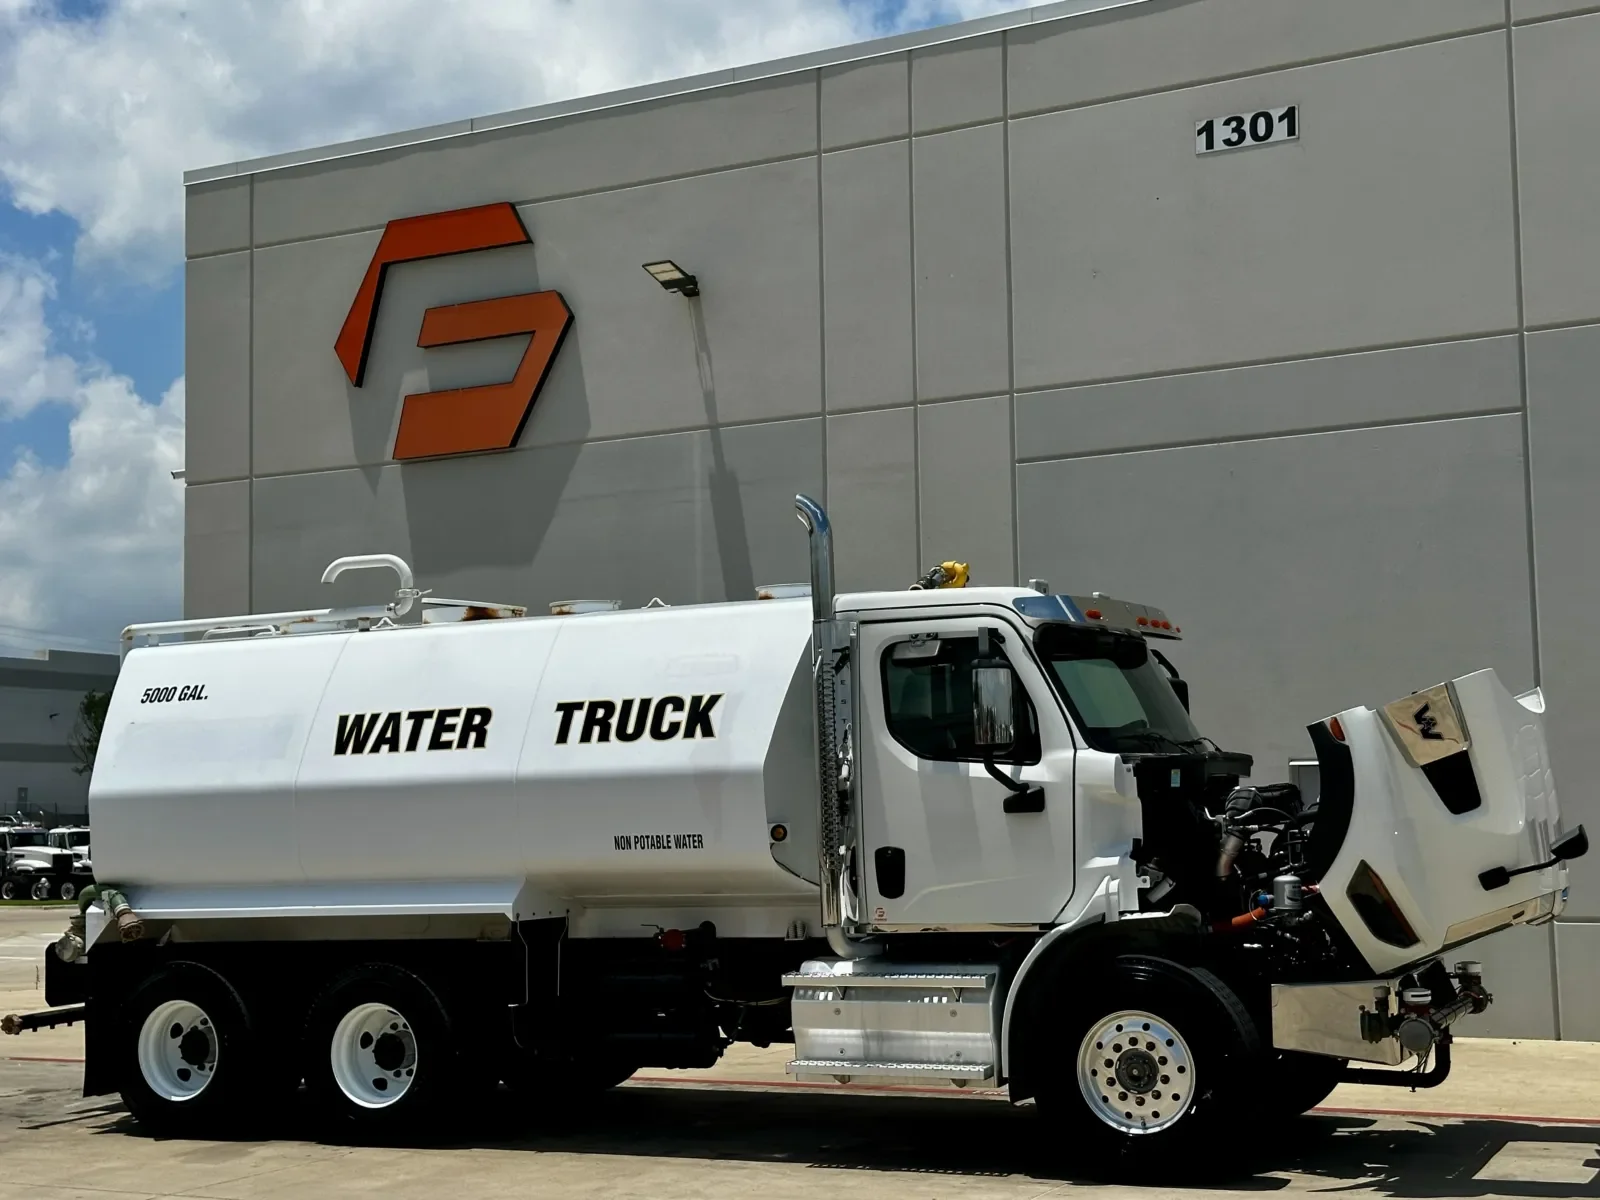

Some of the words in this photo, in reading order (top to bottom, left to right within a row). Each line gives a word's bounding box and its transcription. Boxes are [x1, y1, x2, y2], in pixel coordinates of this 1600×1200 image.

[1196, 105, 1297, 151] 1301
[140, 686, 178, 704] 5000
[177, 684, 209, 702] GAL.
[332, 706, 494, 757] WATER
[553, 692, 728, 746] TRUCK
[613, 835, 632, 851] NON
[633, 834, 672, 850] POTABLE
[673, 833, 704, 849] WATER
